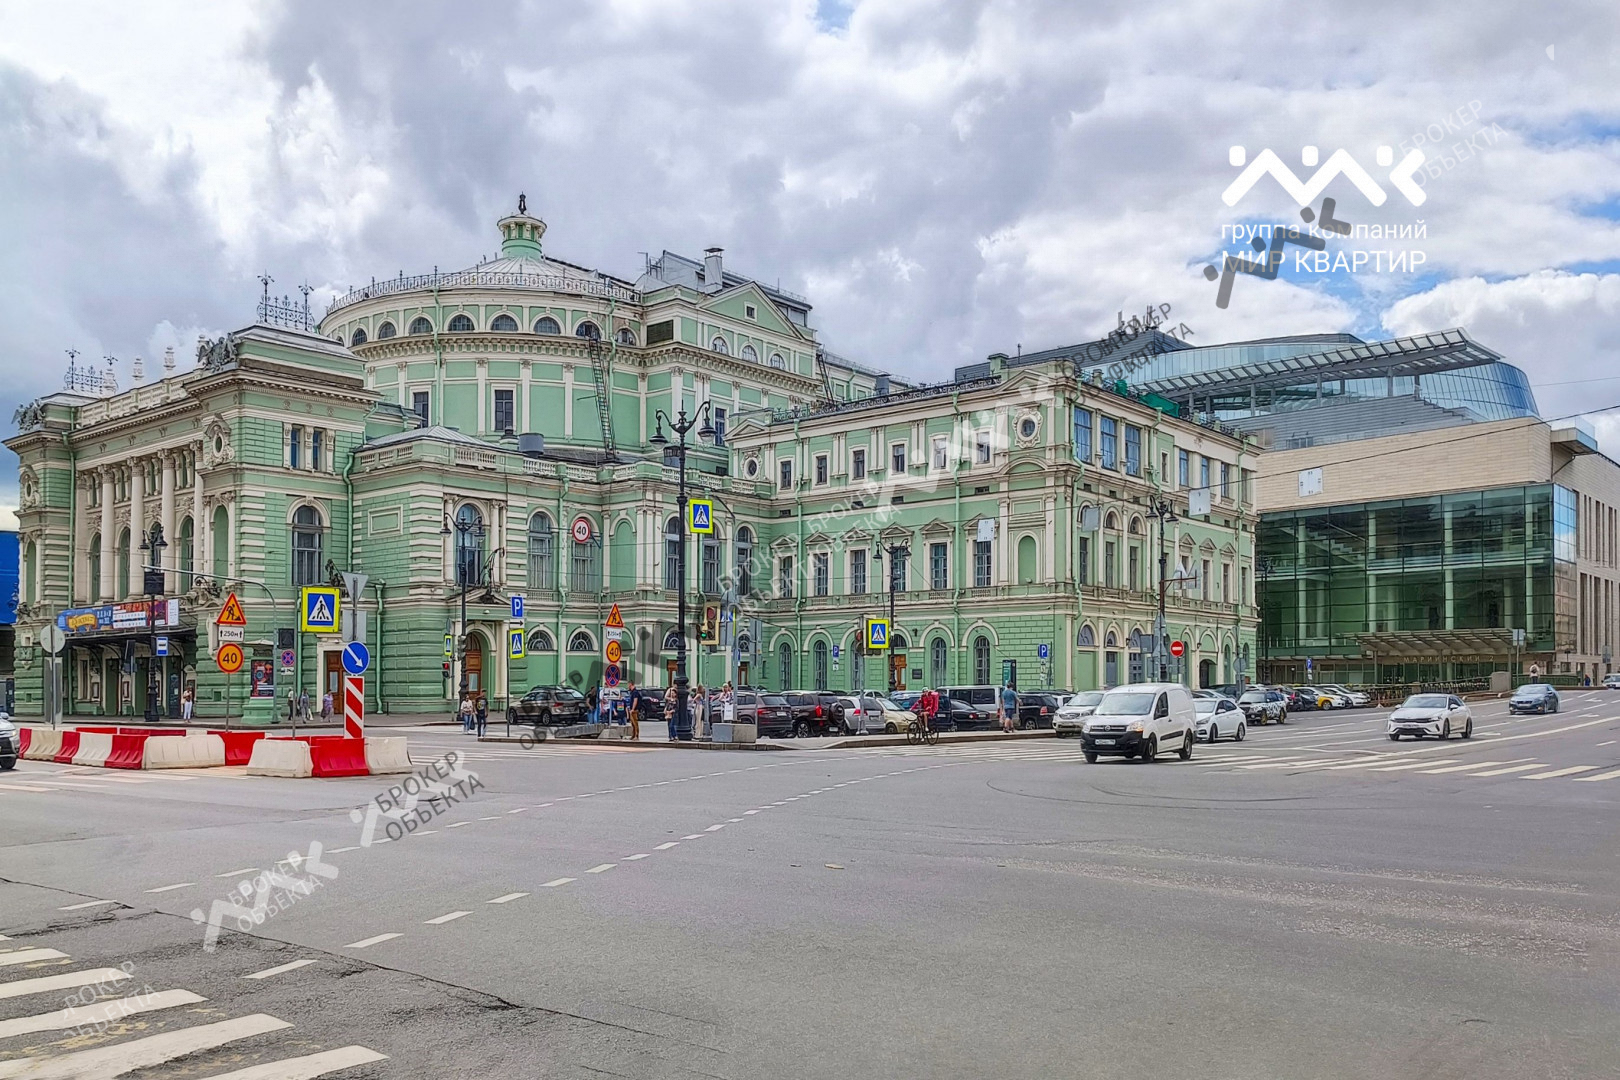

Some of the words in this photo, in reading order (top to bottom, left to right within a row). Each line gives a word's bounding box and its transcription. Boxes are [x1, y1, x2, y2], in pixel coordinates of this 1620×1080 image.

[576, 526, 587, 535] 40
[609, 647, 619, 657] 40
[222, 652, 238, 664] 40
